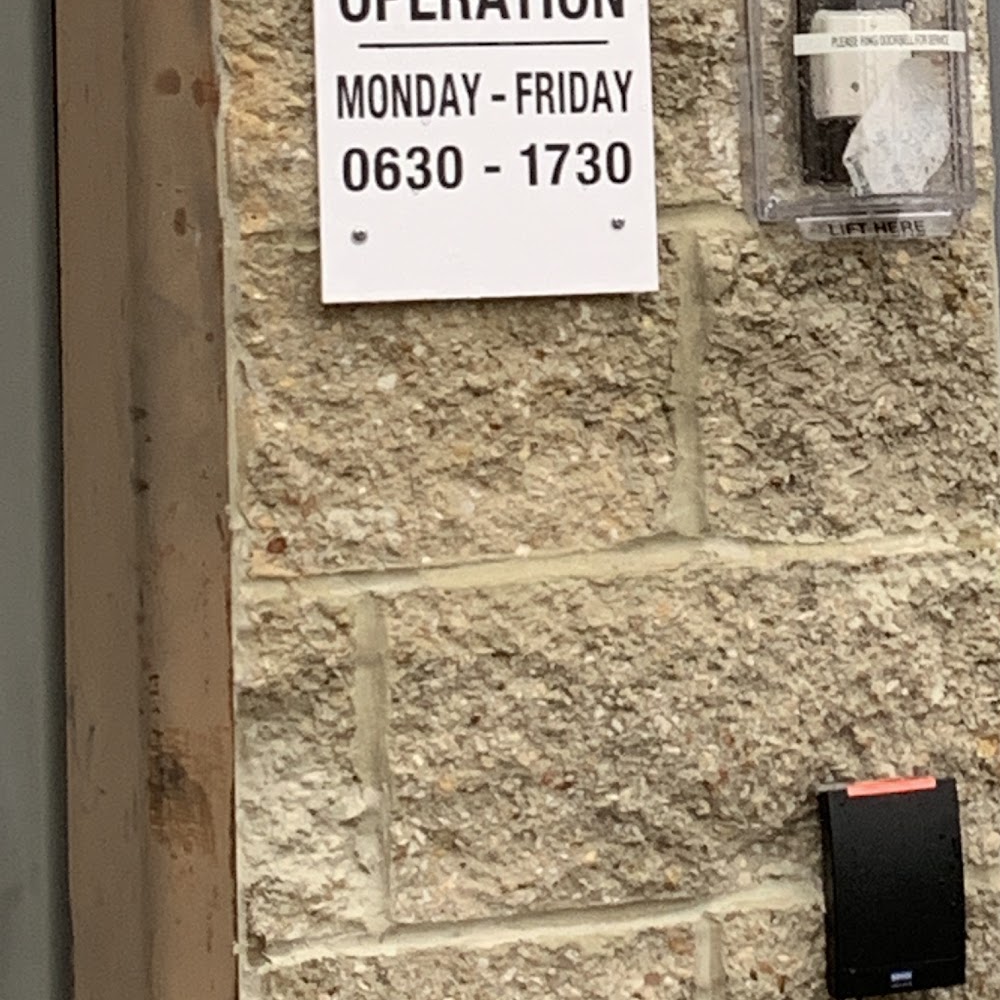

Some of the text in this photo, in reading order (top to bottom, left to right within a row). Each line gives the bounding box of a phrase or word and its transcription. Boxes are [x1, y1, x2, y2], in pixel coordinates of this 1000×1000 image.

[336, 69, 633, 119] MONDAY - FRIDAY
[342, 141, 632, 192] 0630 - 1730
[828, 220, 926, 236] LIFT HERE
